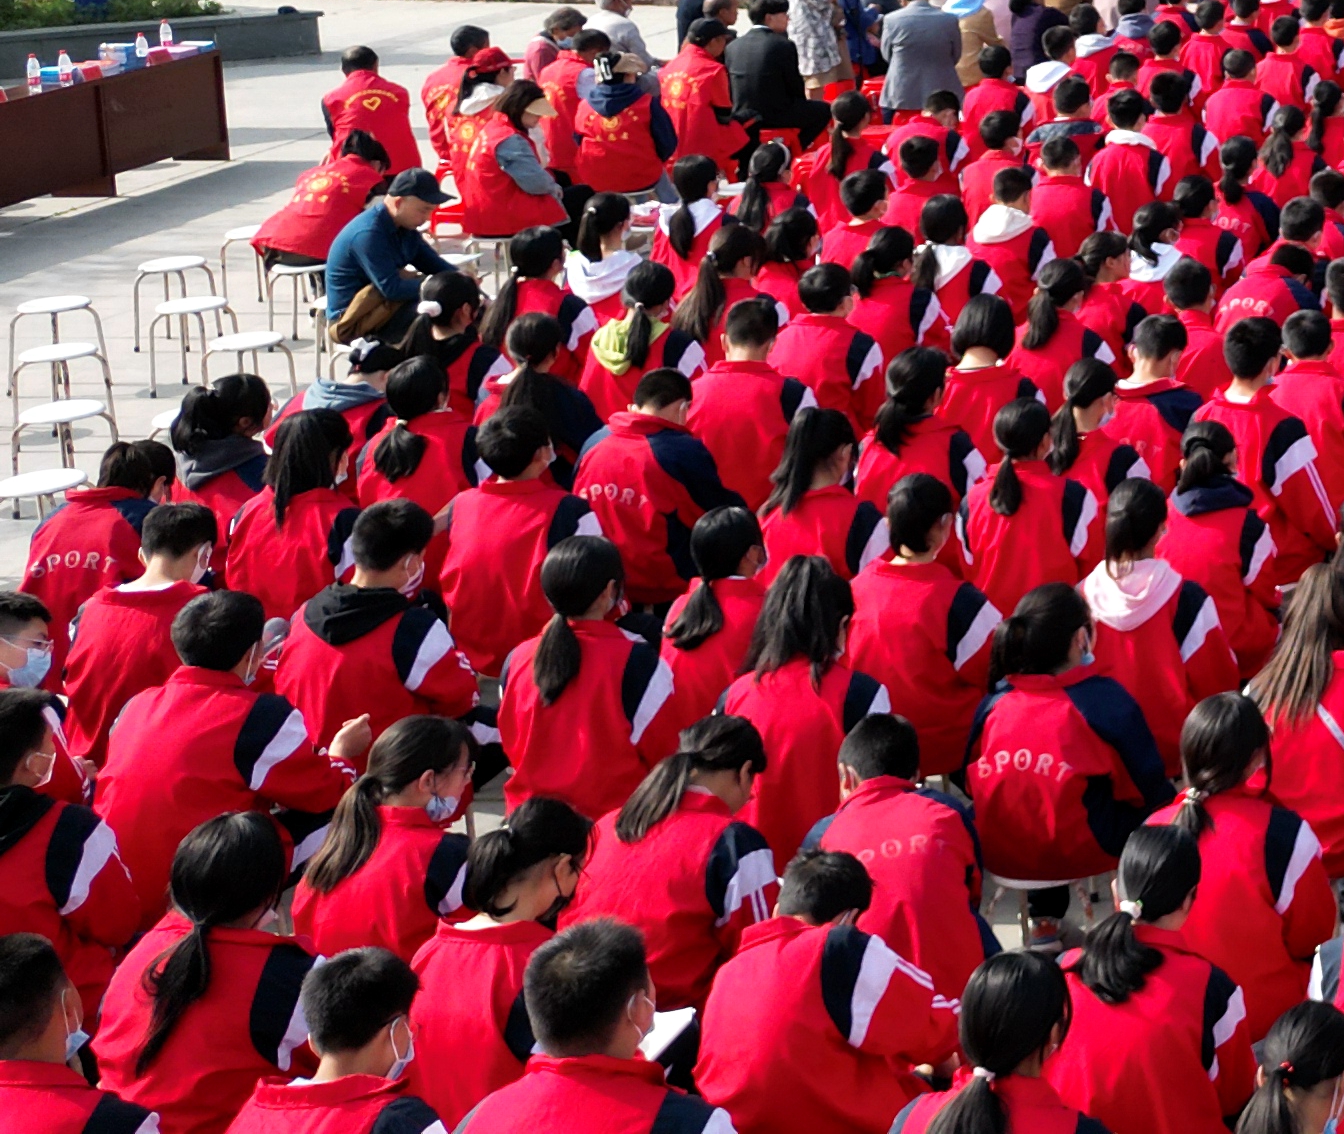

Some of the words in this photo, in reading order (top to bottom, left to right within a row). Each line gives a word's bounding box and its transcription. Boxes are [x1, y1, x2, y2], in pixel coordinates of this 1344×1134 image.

[29, 550, 117, 579] SPORT
[977, 748, 1073, 783] SPORT
[855, 833, 946, 865] PORT
